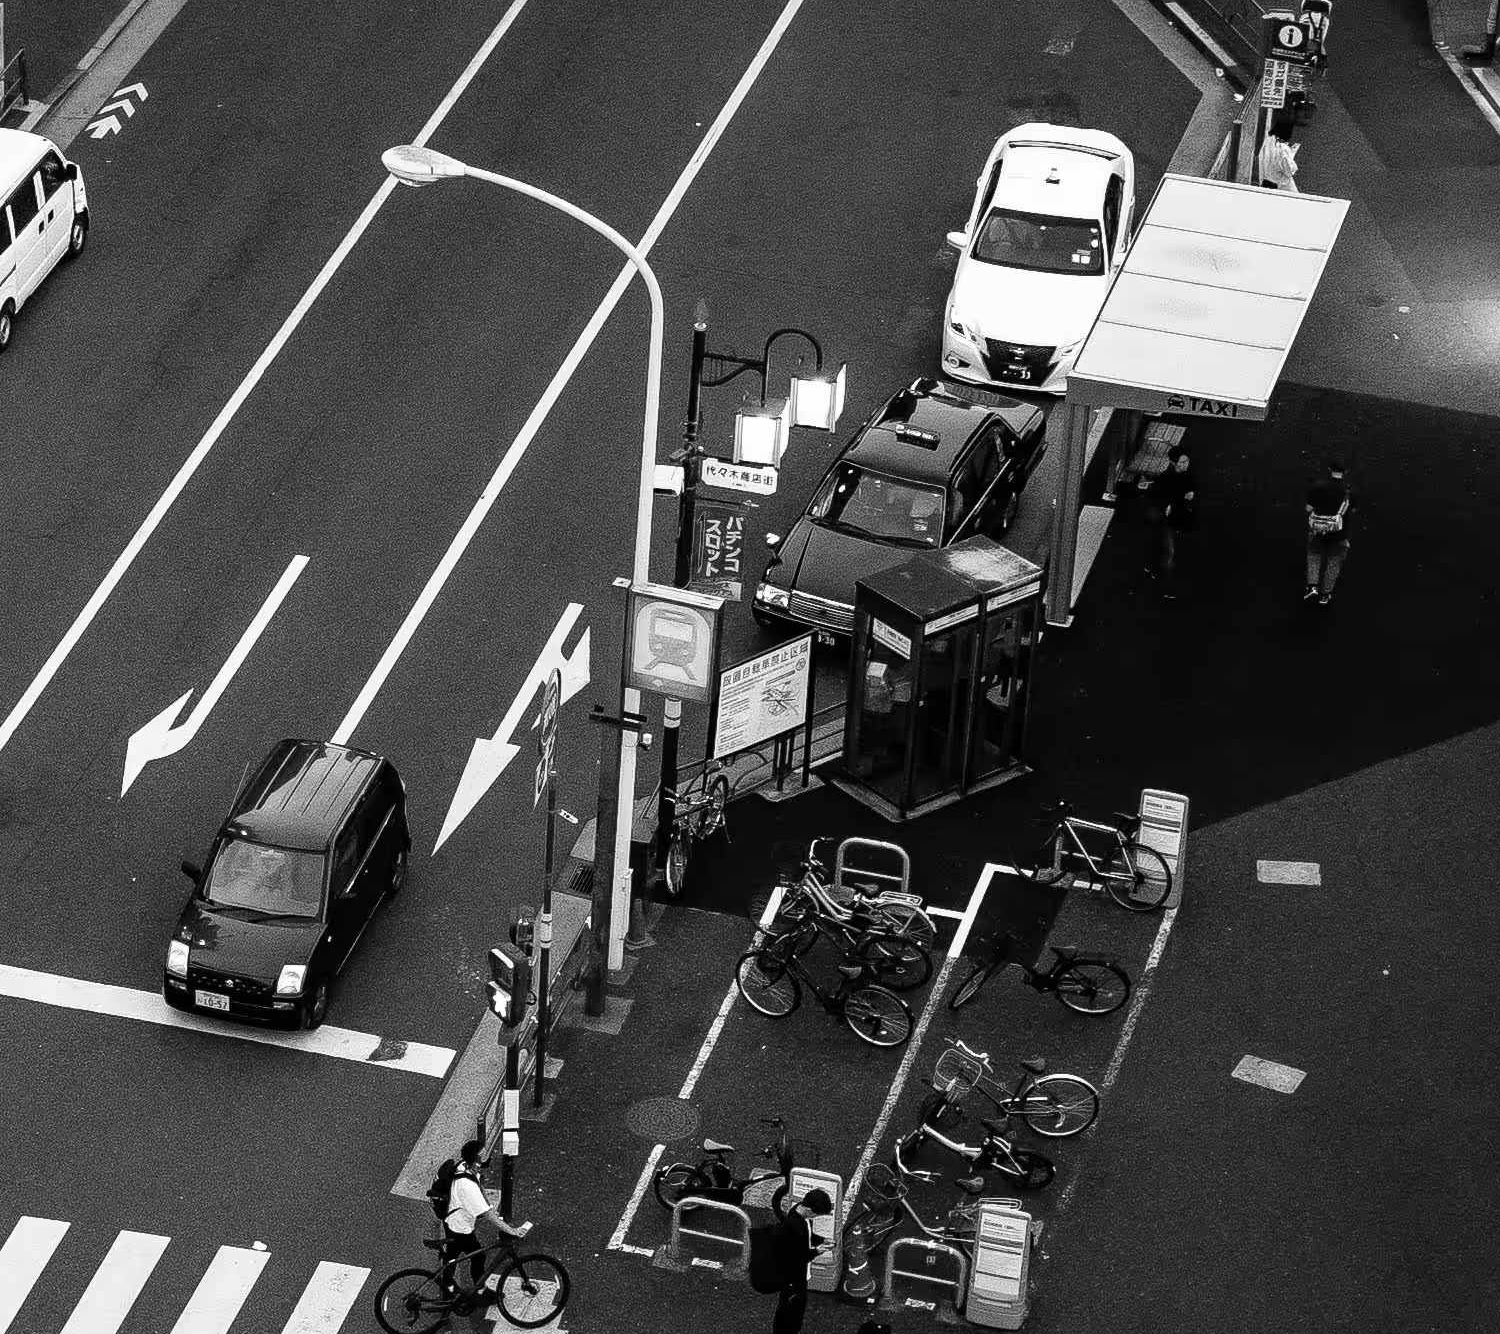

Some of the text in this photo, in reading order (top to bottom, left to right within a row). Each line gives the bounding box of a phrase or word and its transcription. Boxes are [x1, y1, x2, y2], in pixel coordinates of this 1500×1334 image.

[1189, 397, 1237, 417] TAXI
[705, 519, 721, 577] スロット
[724, 516, 744, 573] パチンコ
